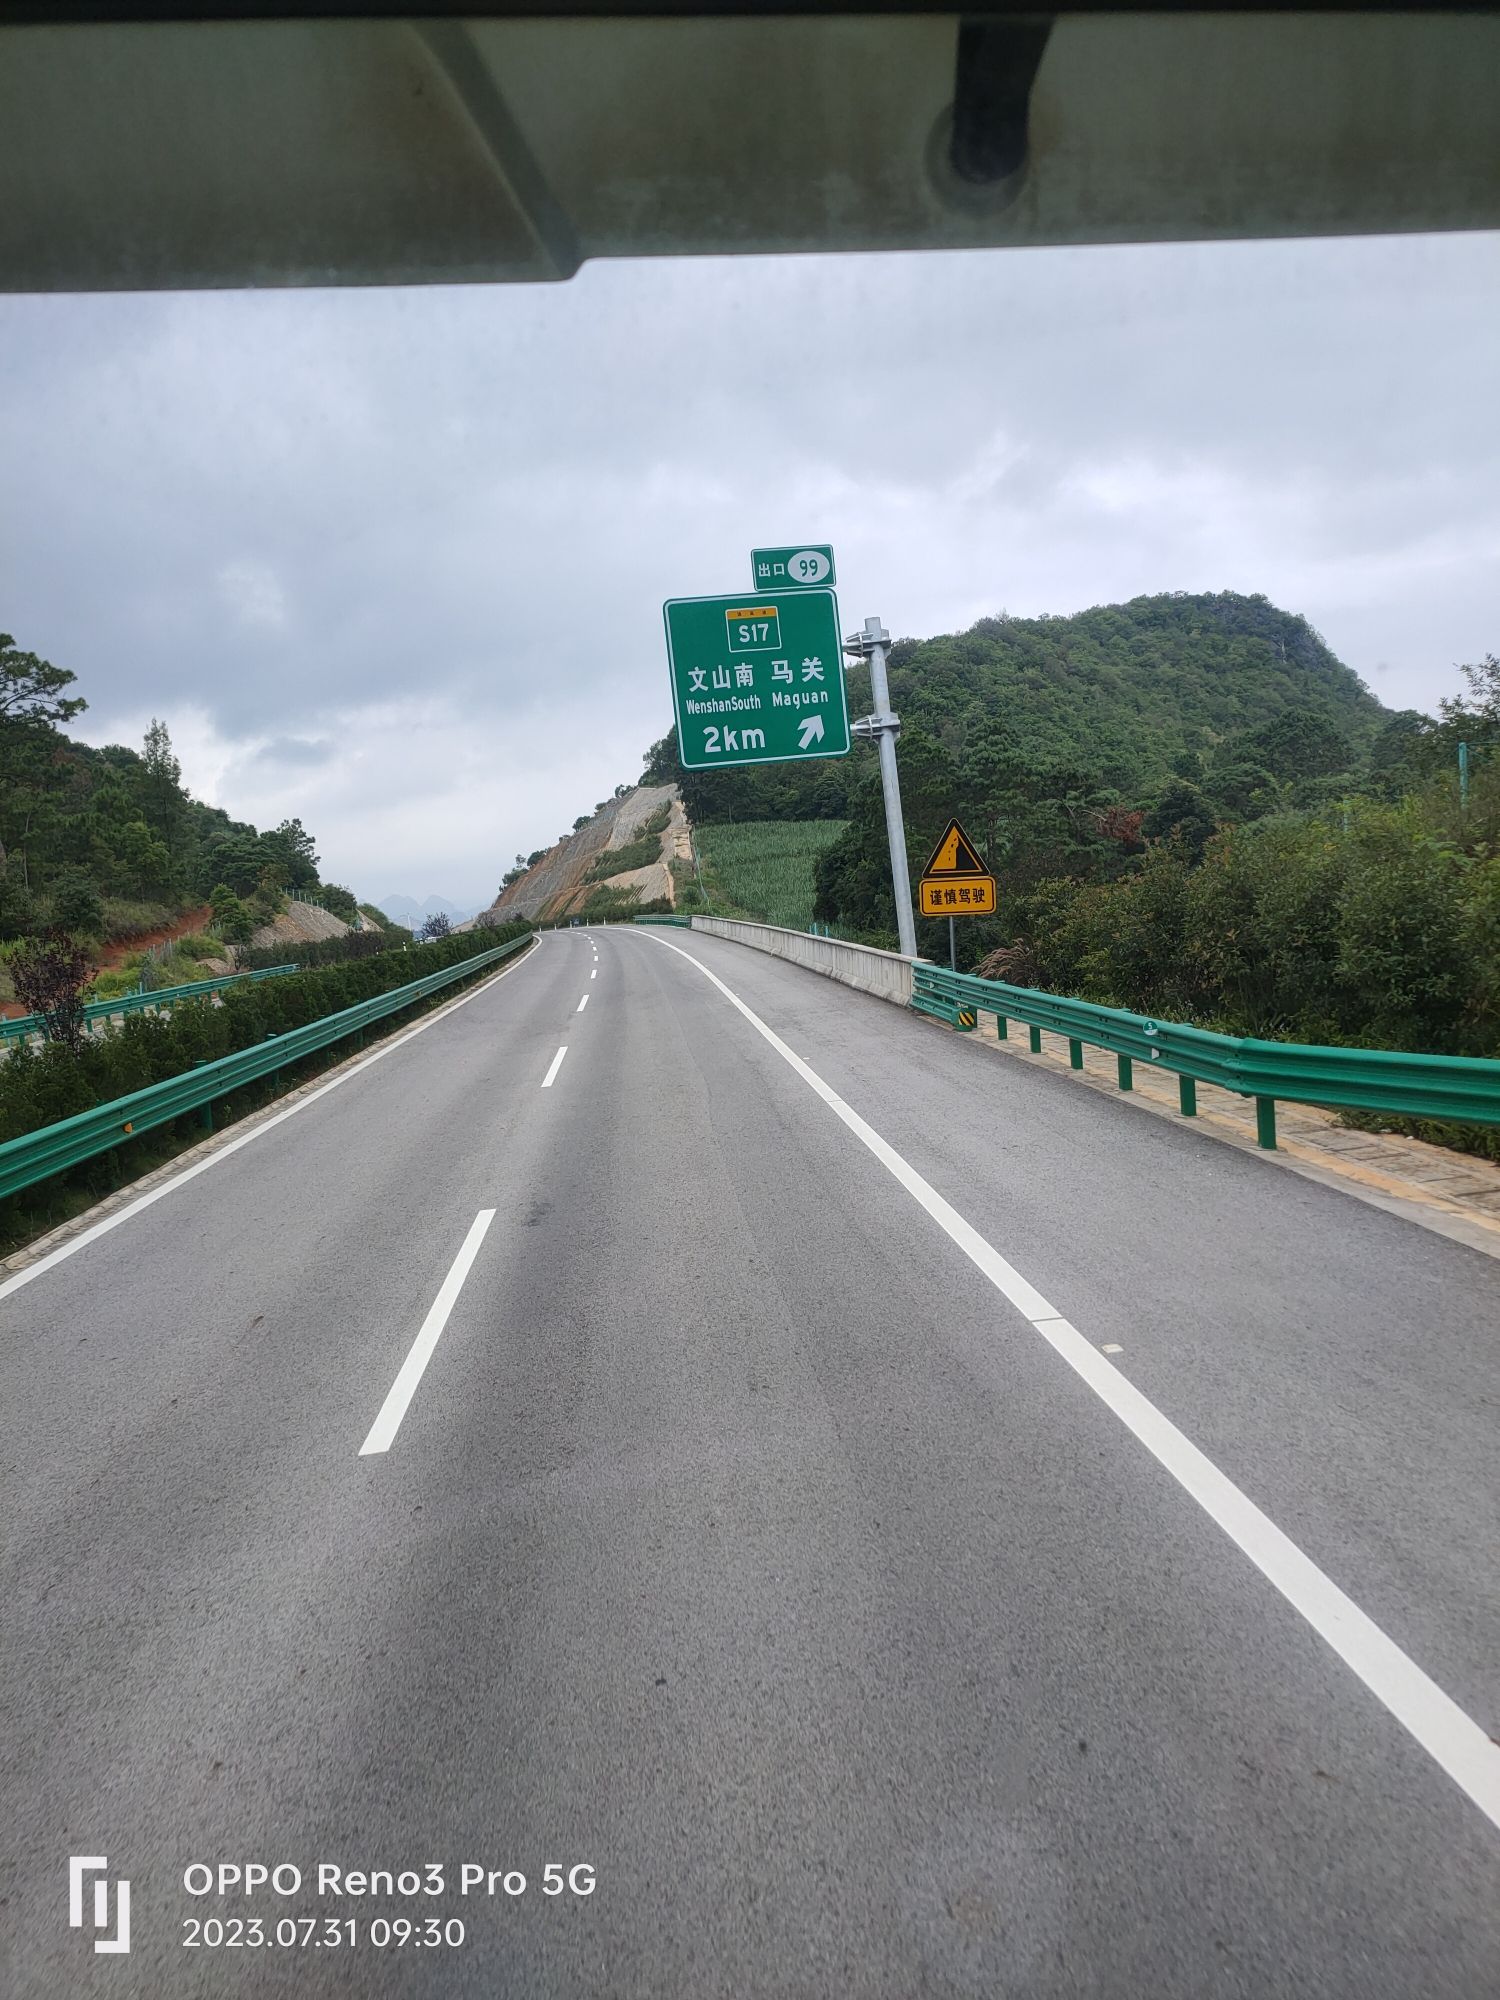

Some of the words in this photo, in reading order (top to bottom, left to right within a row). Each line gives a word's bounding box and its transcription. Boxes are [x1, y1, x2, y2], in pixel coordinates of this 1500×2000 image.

[758, 563, 785, 577] 出口
[799, 559, 818, 577] 99
[739, 623, 769, 643] S17
[687, 662, 754, 693] 文山南
[771, 656, 825, 684] 马关
[686, 694, 761, 715] WenshanSouth
[772, 690, 829, 709] Maguan
[702, 725, 766, 753] 2km
[930, 887, 985, 906] 谨慎驾驶
